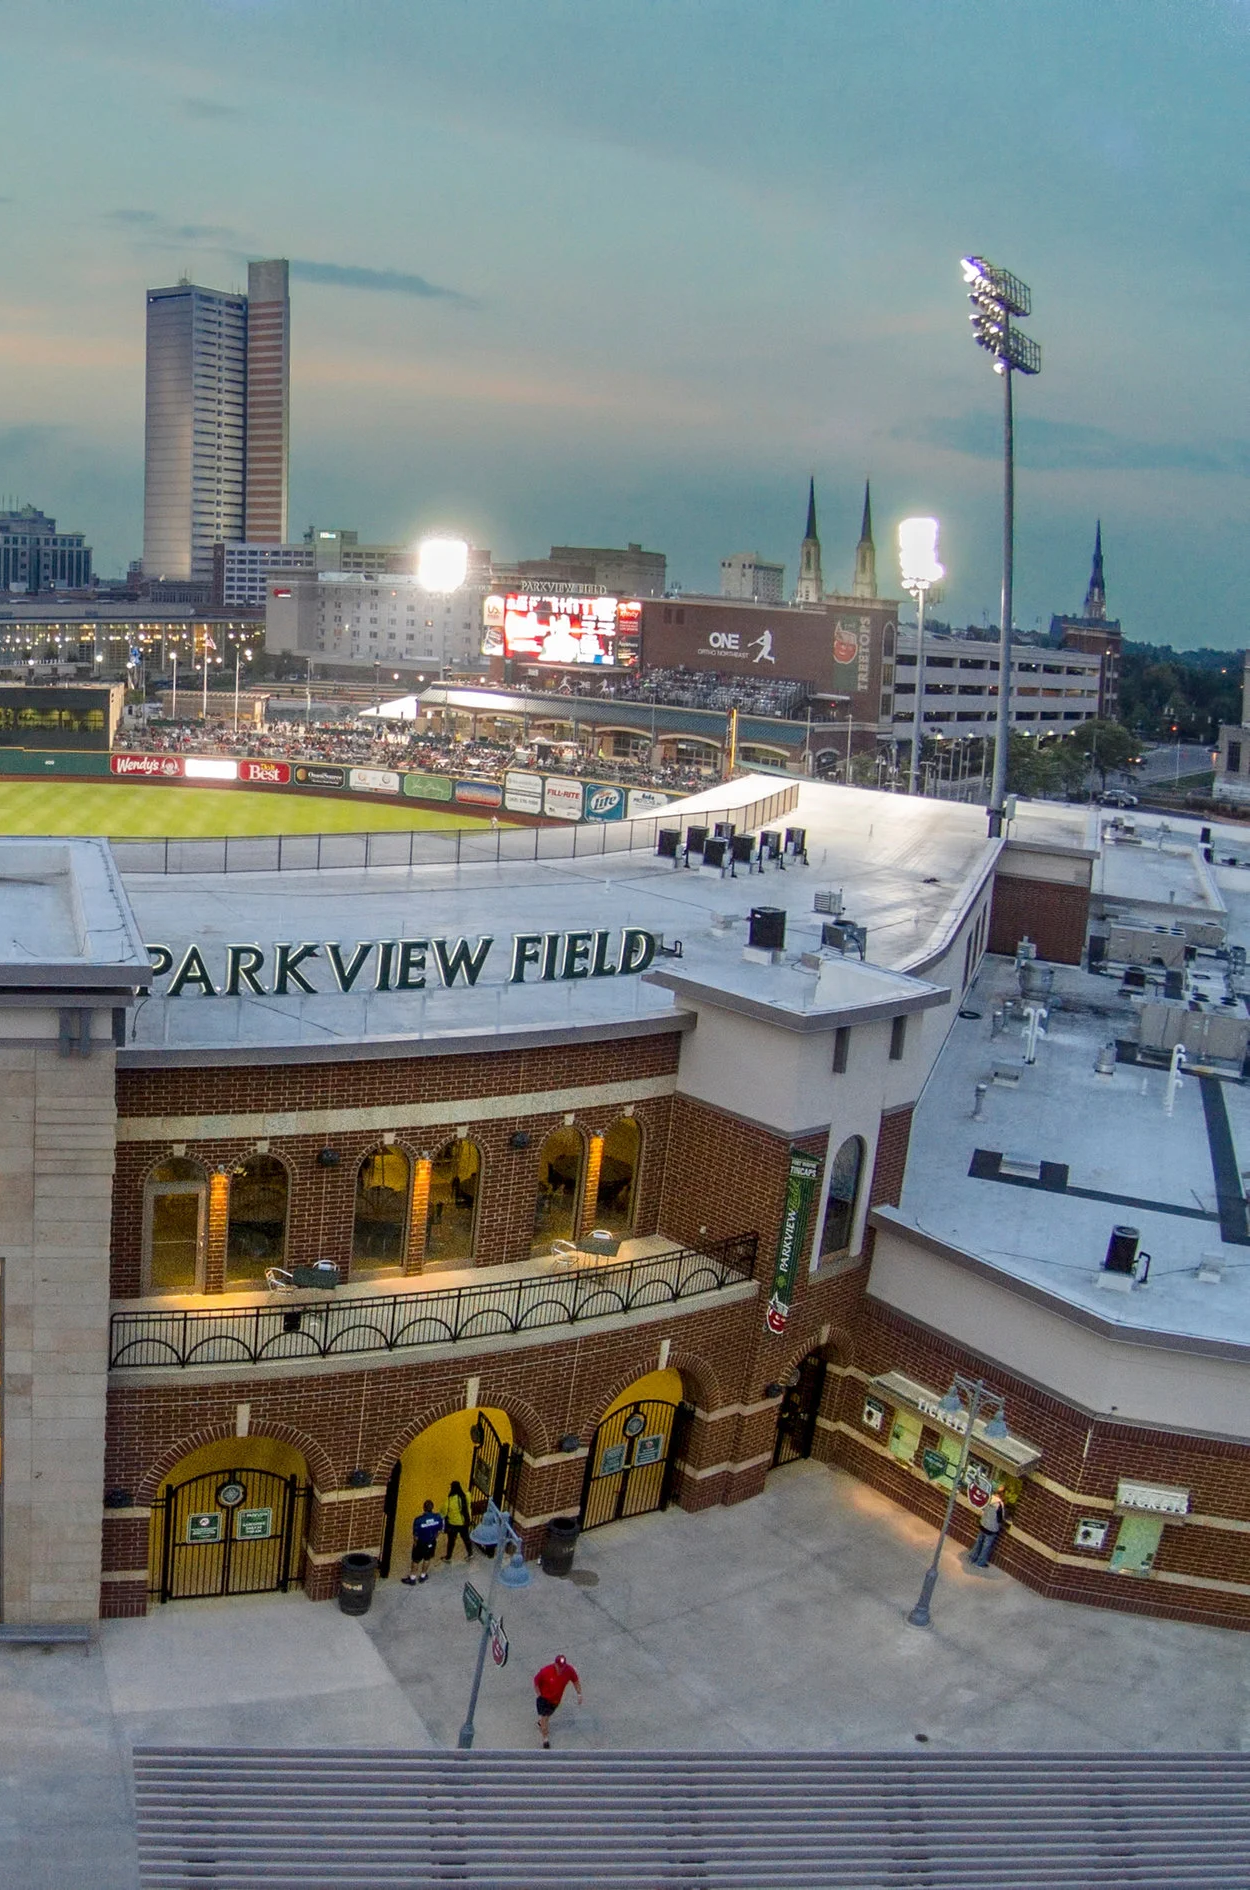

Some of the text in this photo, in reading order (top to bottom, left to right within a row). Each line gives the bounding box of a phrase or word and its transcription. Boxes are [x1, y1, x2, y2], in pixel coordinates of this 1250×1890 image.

[520, 580, 607, 595] PARKVIEW FIELD
[709, 632, 740, 650] ONE
[117, 756, 159, 774] Wendy's
[249, 765, 280, 781] Best
[547, 788, 581, 799] FILL-RITE
[593, 796, 617, 810] Lite
[136, 926, 656, 997] PARKVIEW FIELD
[779, 1207, 798, 1272] PARKVIEW
[918, 1398, 967, 1436] TICKETS
